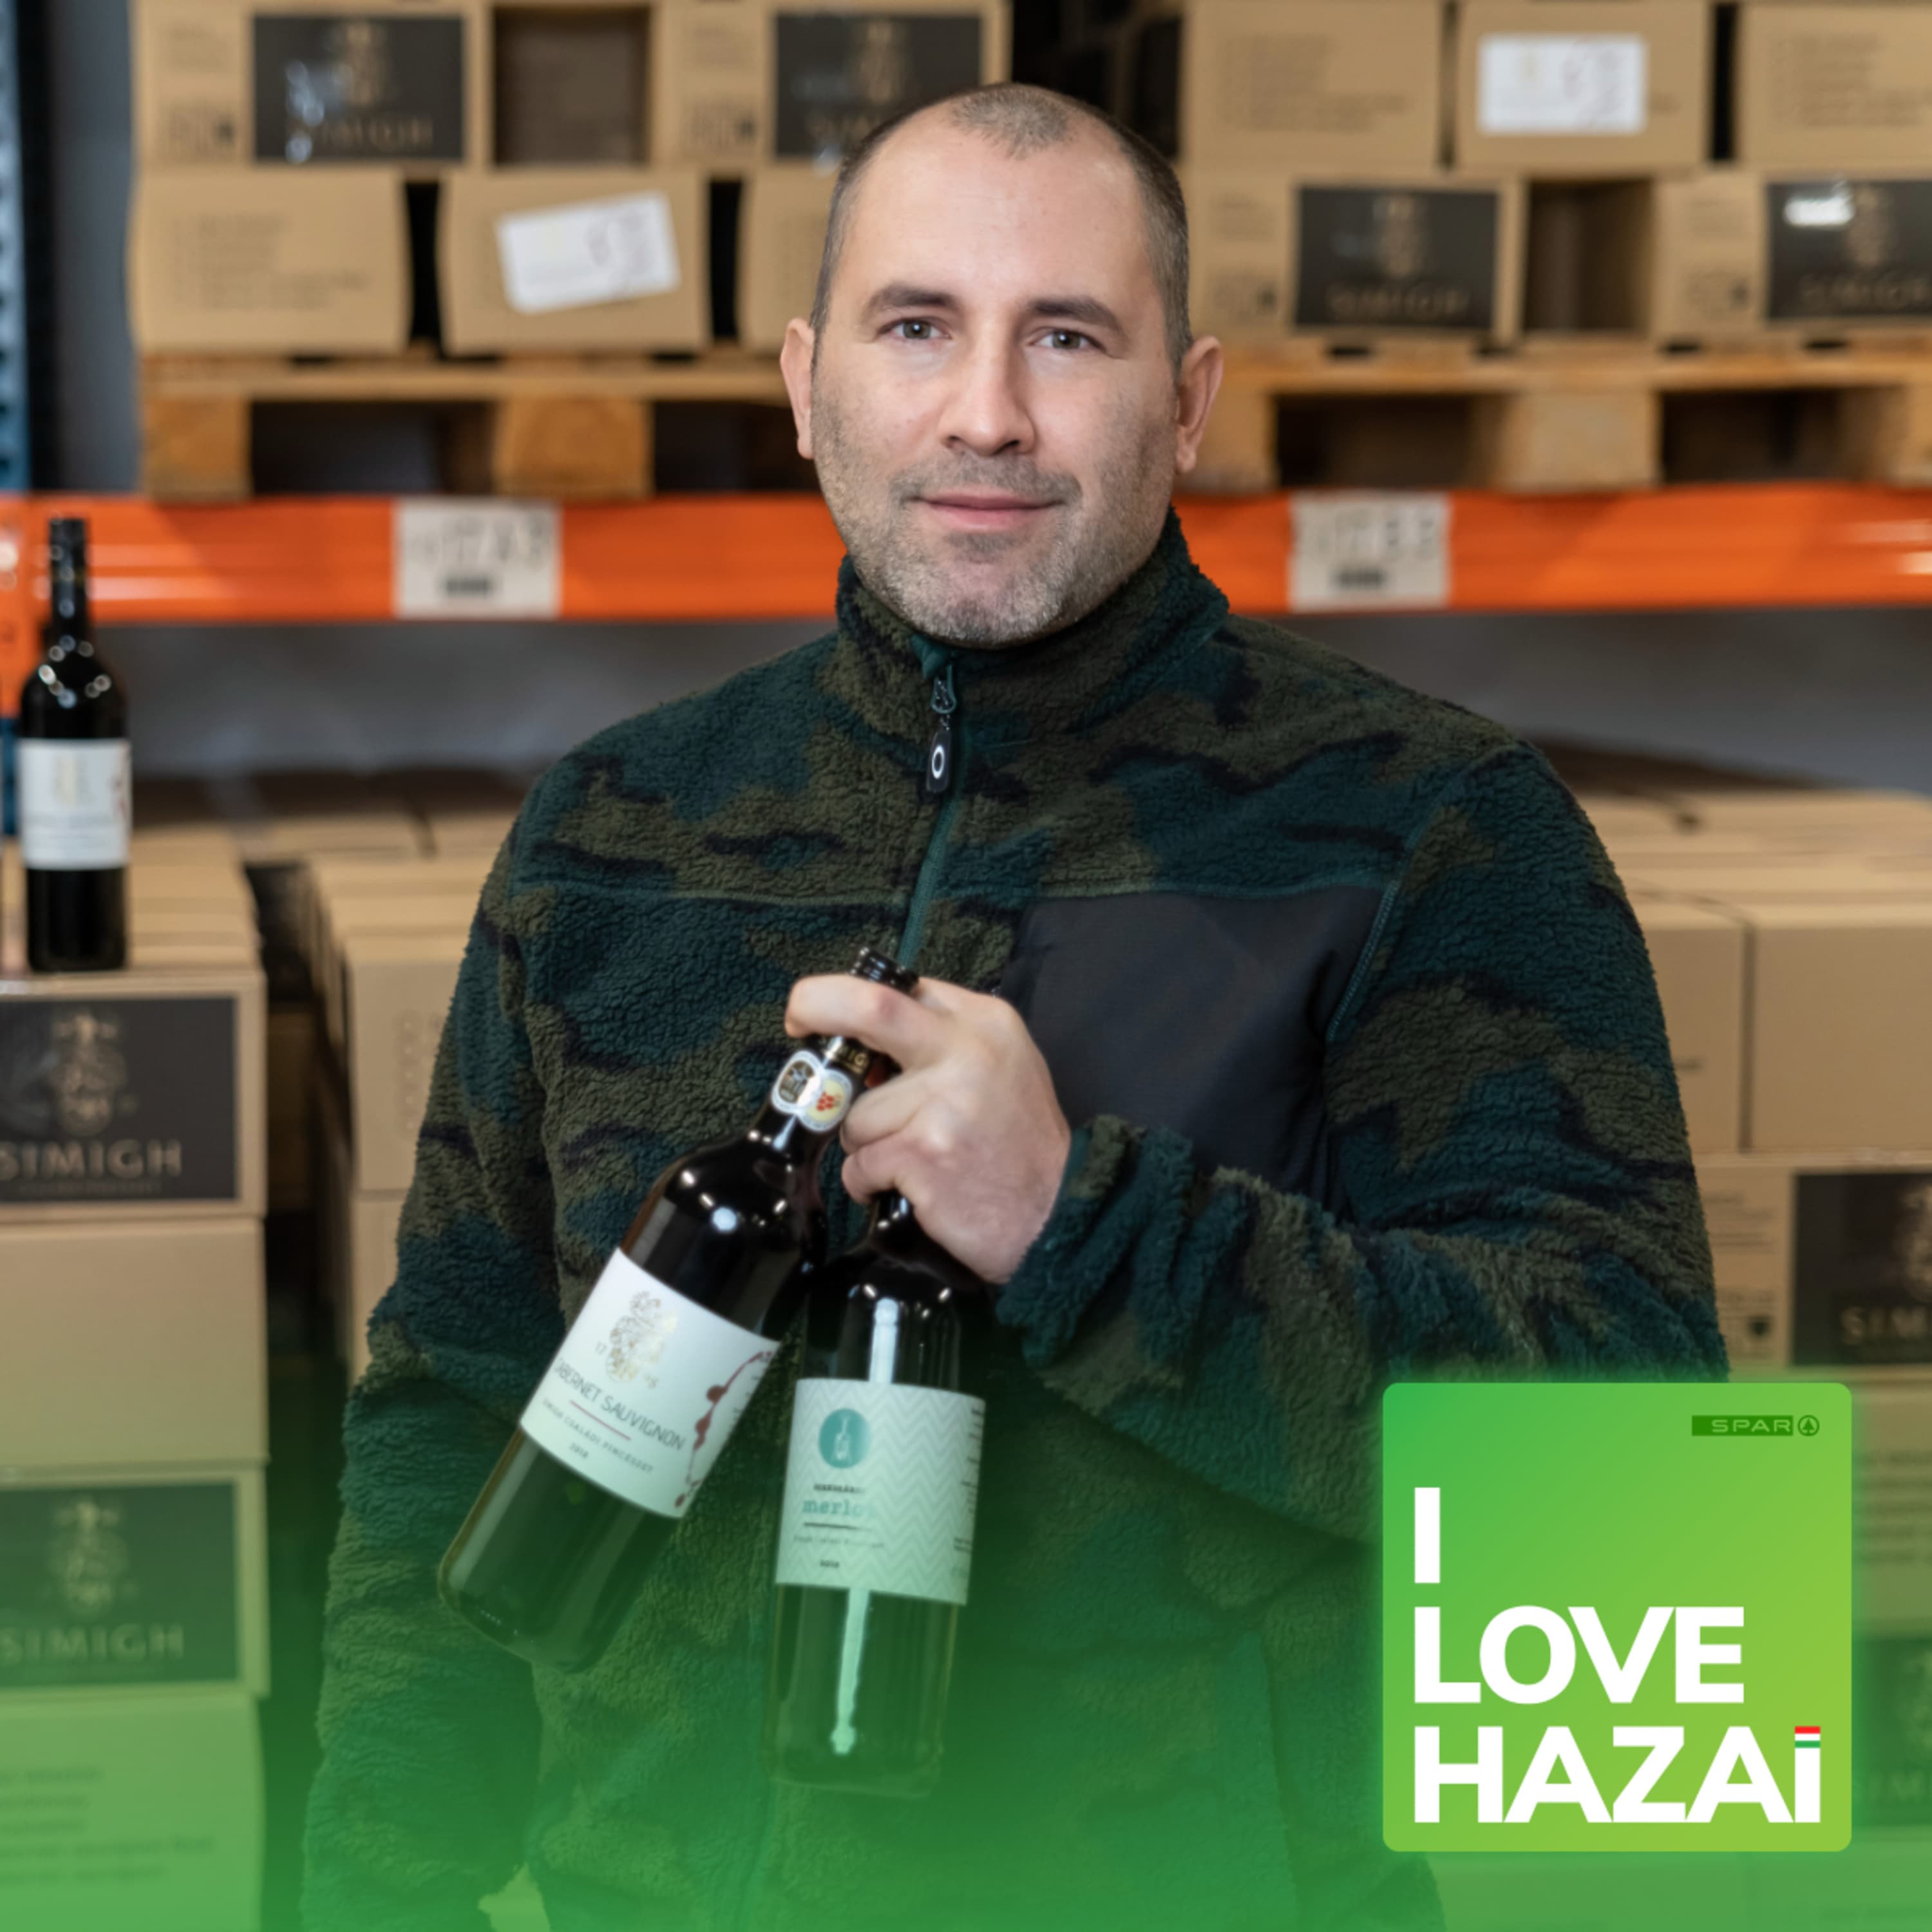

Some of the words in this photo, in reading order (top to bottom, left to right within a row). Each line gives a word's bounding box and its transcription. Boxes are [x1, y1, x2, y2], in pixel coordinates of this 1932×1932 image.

[0, 1139, 182, 1180] SIMIGH
[601, 1395, 687, 1452] SAUVIGNON
[802, 1499, 875, 1519] merlo
